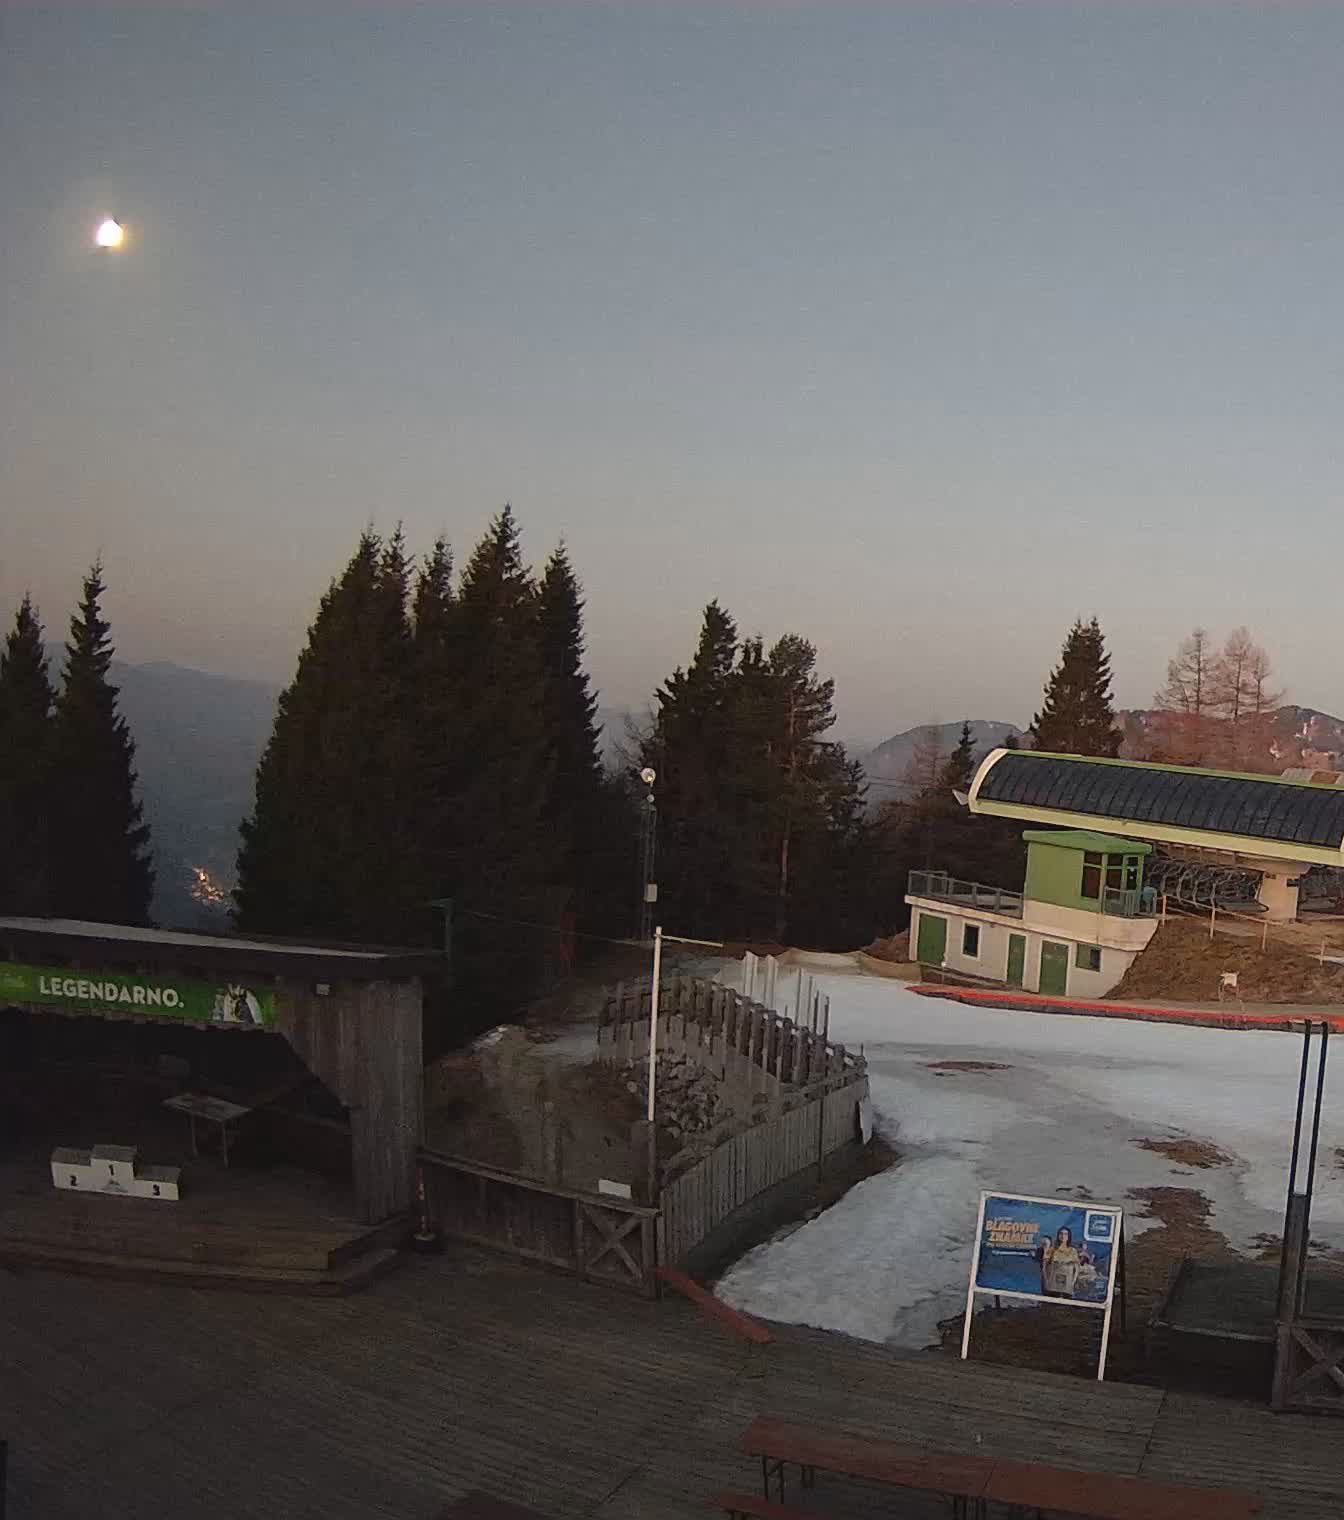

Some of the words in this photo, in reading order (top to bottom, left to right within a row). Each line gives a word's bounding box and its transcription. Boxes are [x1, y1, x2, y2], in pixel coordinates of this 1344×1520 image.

[39, 975, 185, 1008] LEGENDARNO.
[108, 1164, 115, 1176] 1
[70, 1175, 78, 1187] 2
[152, 1184, 161, 1196] 3
